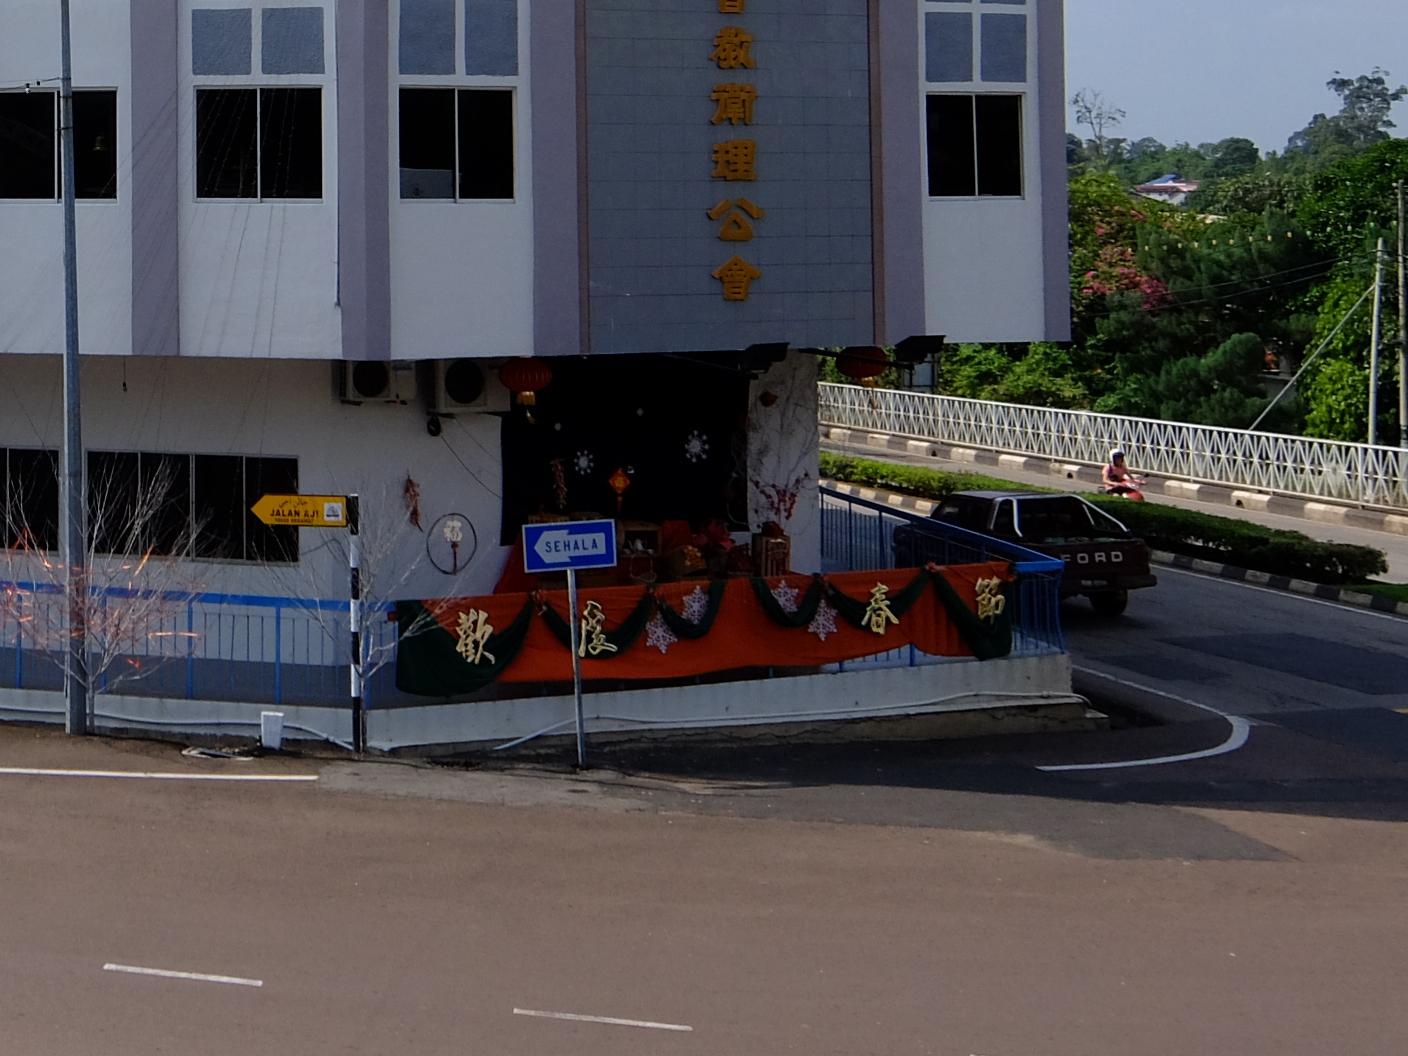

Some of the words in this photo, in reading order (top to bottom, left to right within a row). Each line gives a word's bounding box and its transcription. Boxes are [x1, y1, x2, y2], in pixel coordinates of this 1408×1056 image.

[270, 509, 300, 518] JALAN
[544, 538, 599, 553] SEHALA
[1060, 551, 1123, 564] FORD
